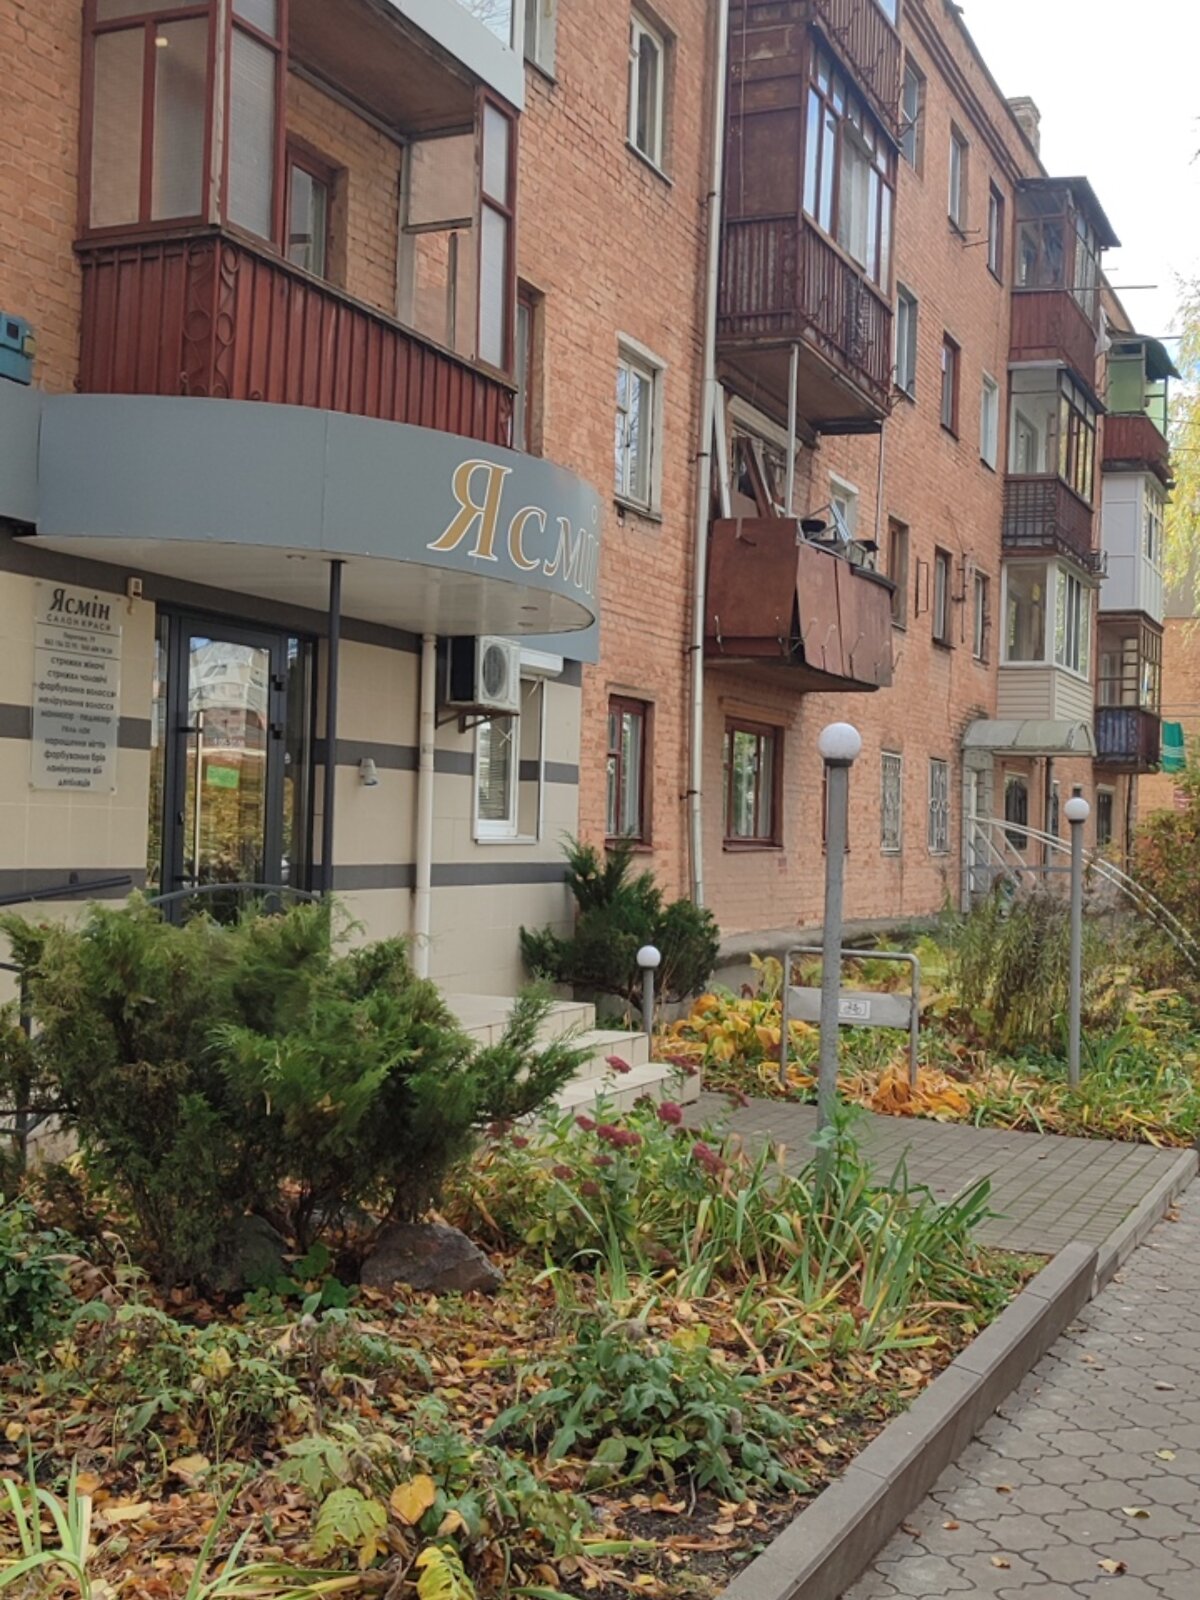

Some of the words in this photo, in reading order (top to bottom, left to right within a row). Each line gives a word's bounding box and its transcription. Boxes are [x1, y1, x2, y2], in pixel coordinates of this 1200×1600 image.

[426, 458, 599, 598] Ясмі
[48, 588, 110, 621] Ясмін
[46, 613, 79, 626] САЛОН
[81, 619, 111, 631] КРАСИ
[38, 681, 84, 693] фарбування
[86, 688, 116, 698] волосся
[85, 701, 114, 711] волосся
